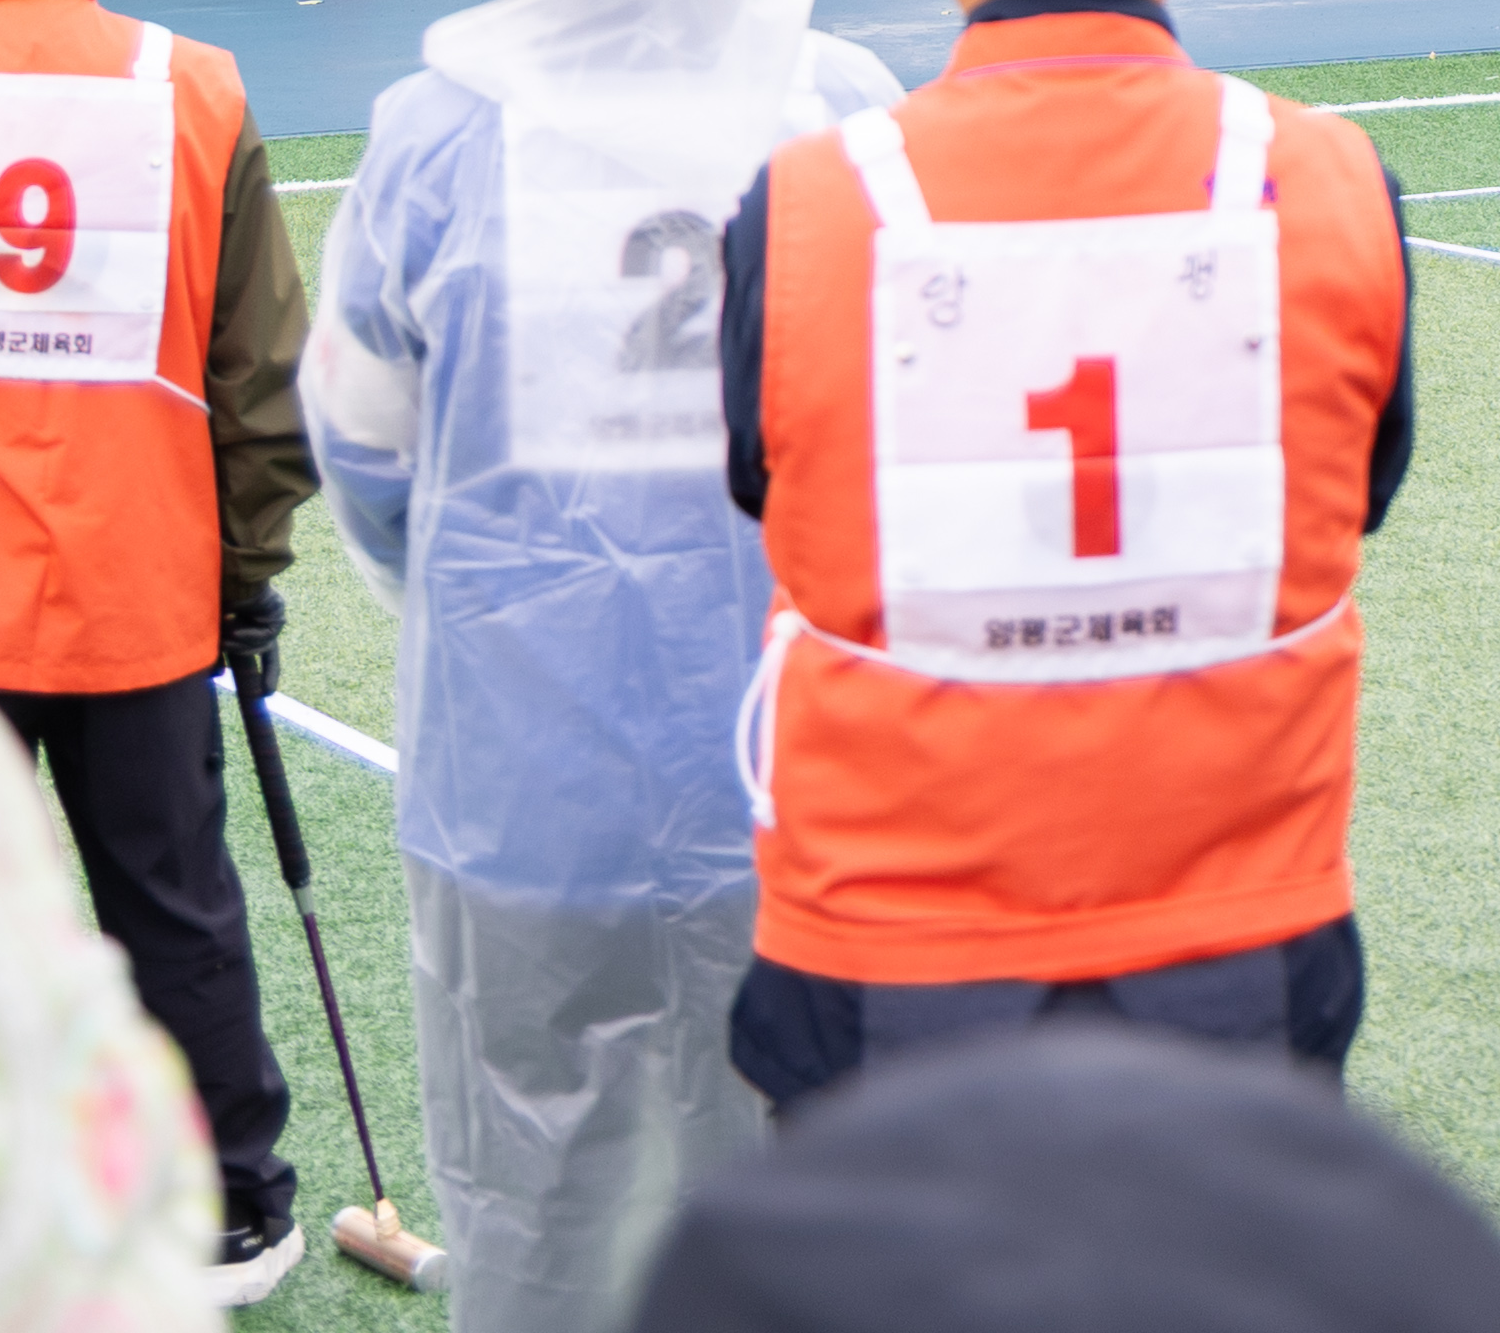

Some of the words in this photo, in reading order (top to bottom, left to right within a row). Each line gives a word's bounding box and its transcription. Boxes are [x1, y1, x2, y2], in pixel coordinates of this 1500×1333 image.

[619, 209, 726, 373] 2
[1025, 355, 1123, 559] 1
[982, 606, 1182, 650] 양평군체육회
